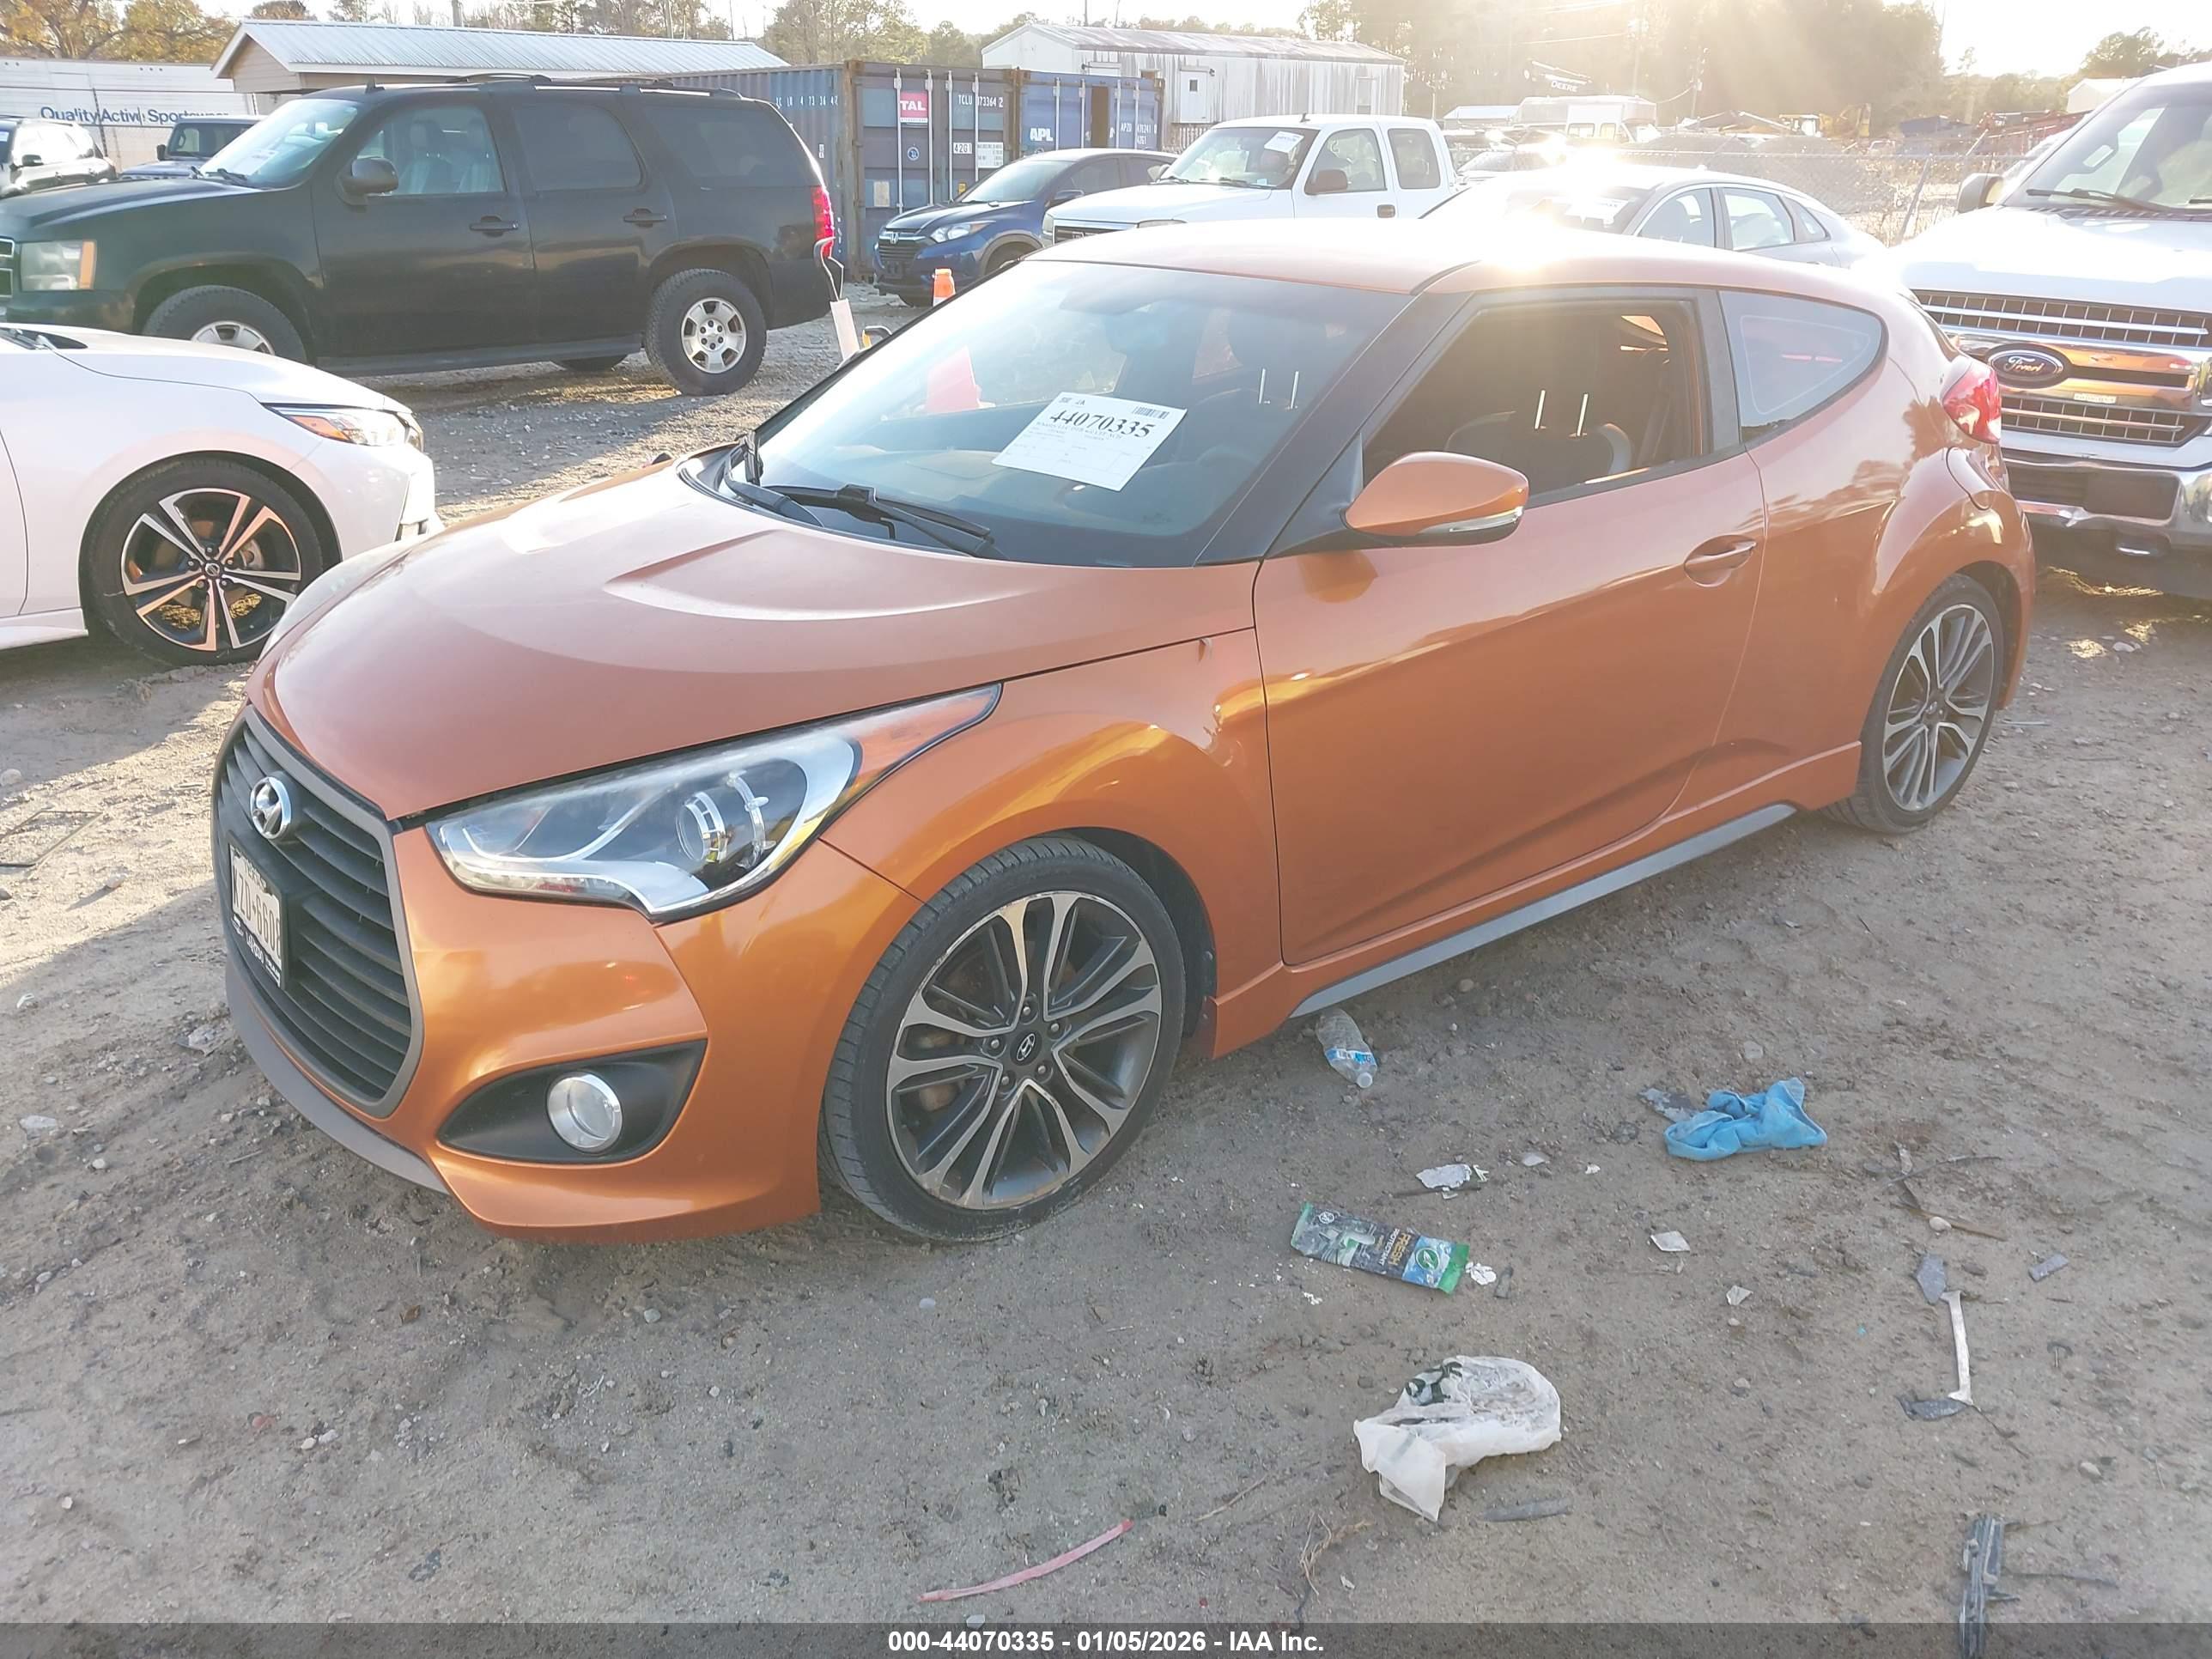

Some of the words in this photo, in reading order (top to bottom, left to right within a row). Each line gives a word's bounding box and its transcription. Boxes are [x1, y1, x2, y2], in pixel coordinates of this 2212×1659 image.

[1551, 81, 1578, 92] DEERE
[900, 100, 927, 111] TAL
[958, 94, 973, 105] TCLU
[40, 106, 100, 124] Quality
[1030, 127, 1054, 142] APL
[2003, 356, 2045, 372] Ford
[1049, 410, 1157, 438] 44070335
[1378, 1228, 1401, 1267] PROTECTANT
[1388, 1232, 1412, 1266] FRESH
